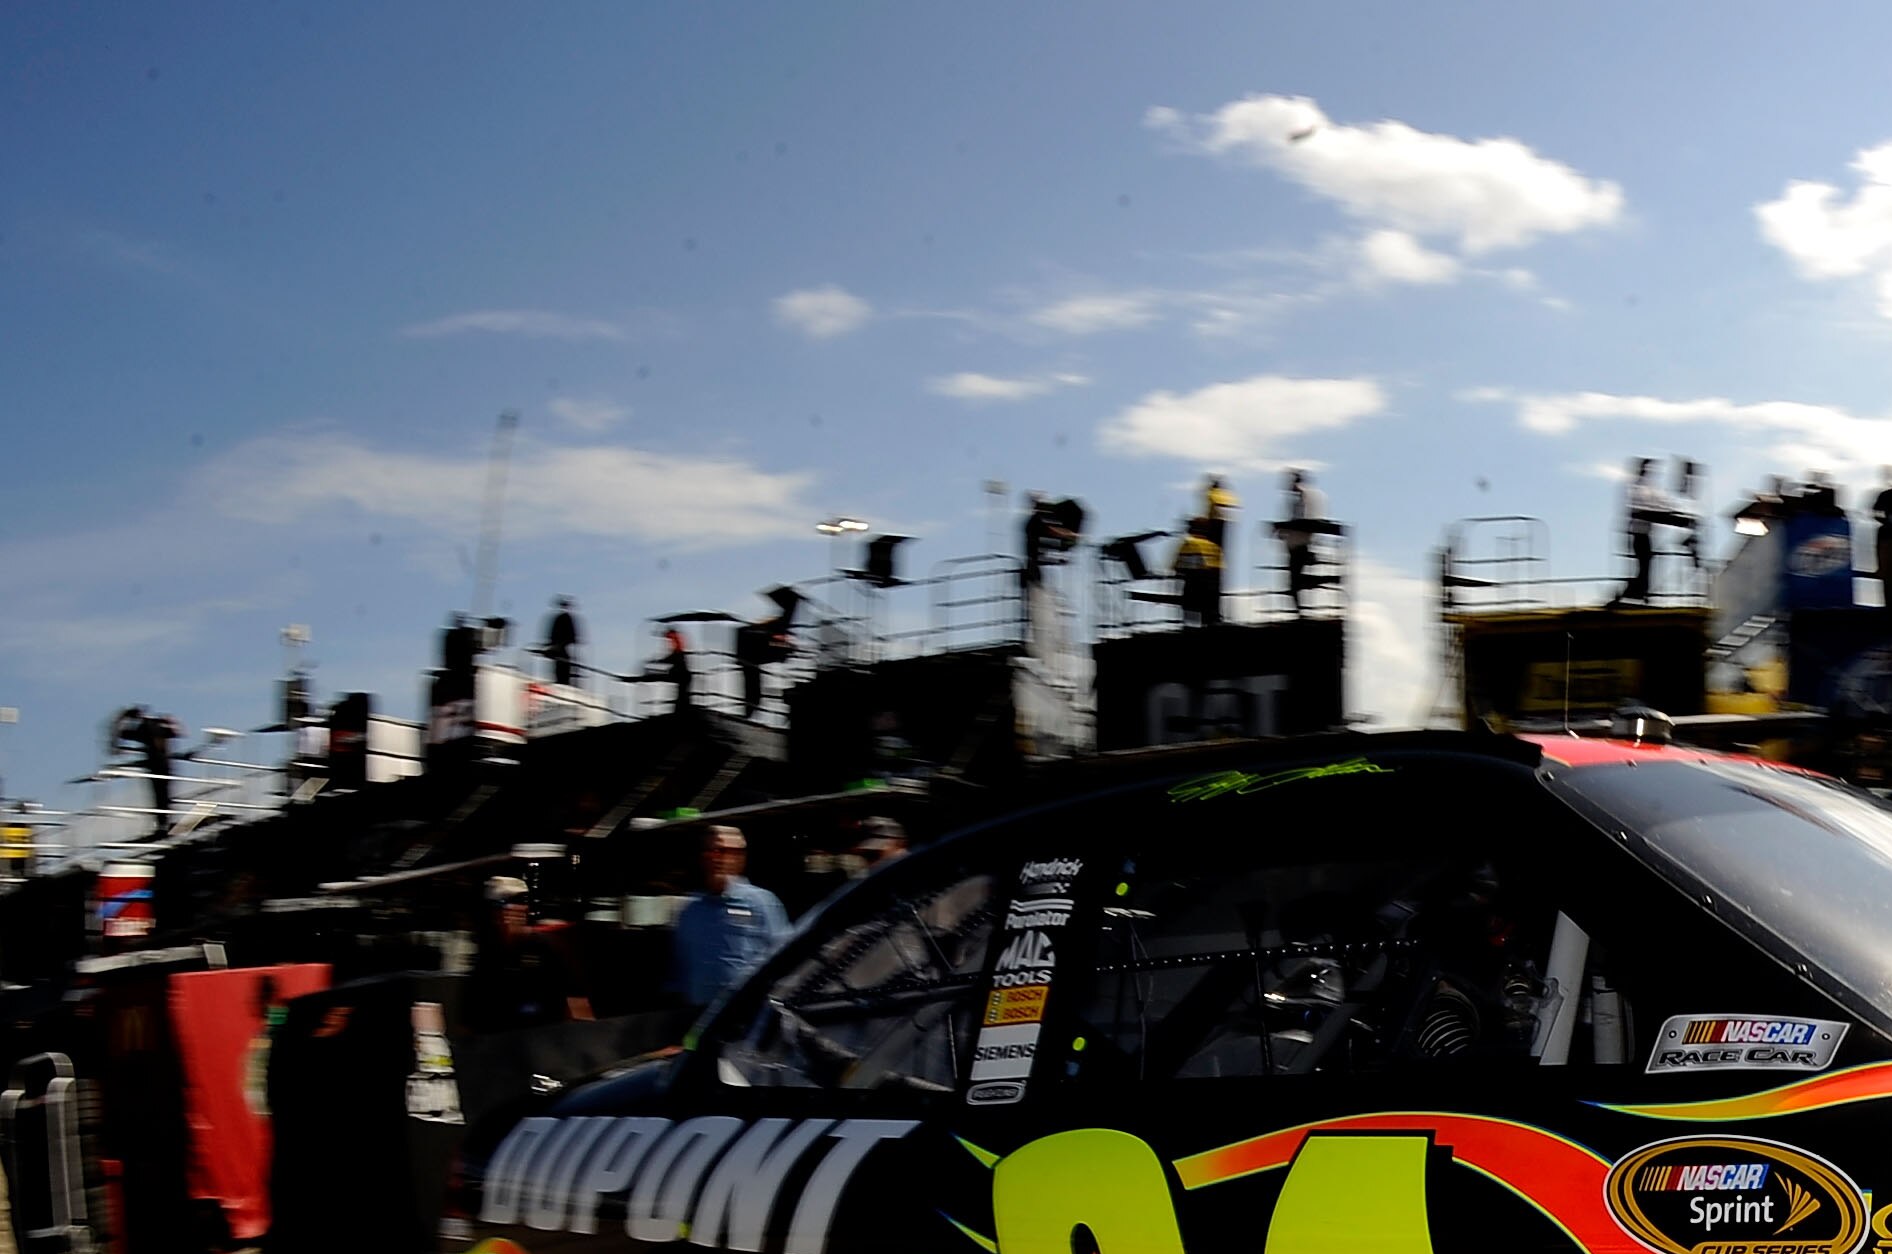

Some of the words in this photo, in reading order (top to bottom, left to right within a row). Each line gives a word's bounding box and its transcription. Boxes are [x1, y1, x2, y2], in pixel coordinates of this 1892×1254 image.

[993, 970, 1052, 987] TOOLS
[1720, 1020, 1811, 1045] NASCAR
[974, 1043, 1036, 1061] SIEMENS
[1658, 1048, 1742, 1067] RACE
[1744, 1047, 1819, 1067] CAR
[1676, 1164, 1765, 1191] NASCAR
[1689, 1194, 1774, 1231] Sprint
